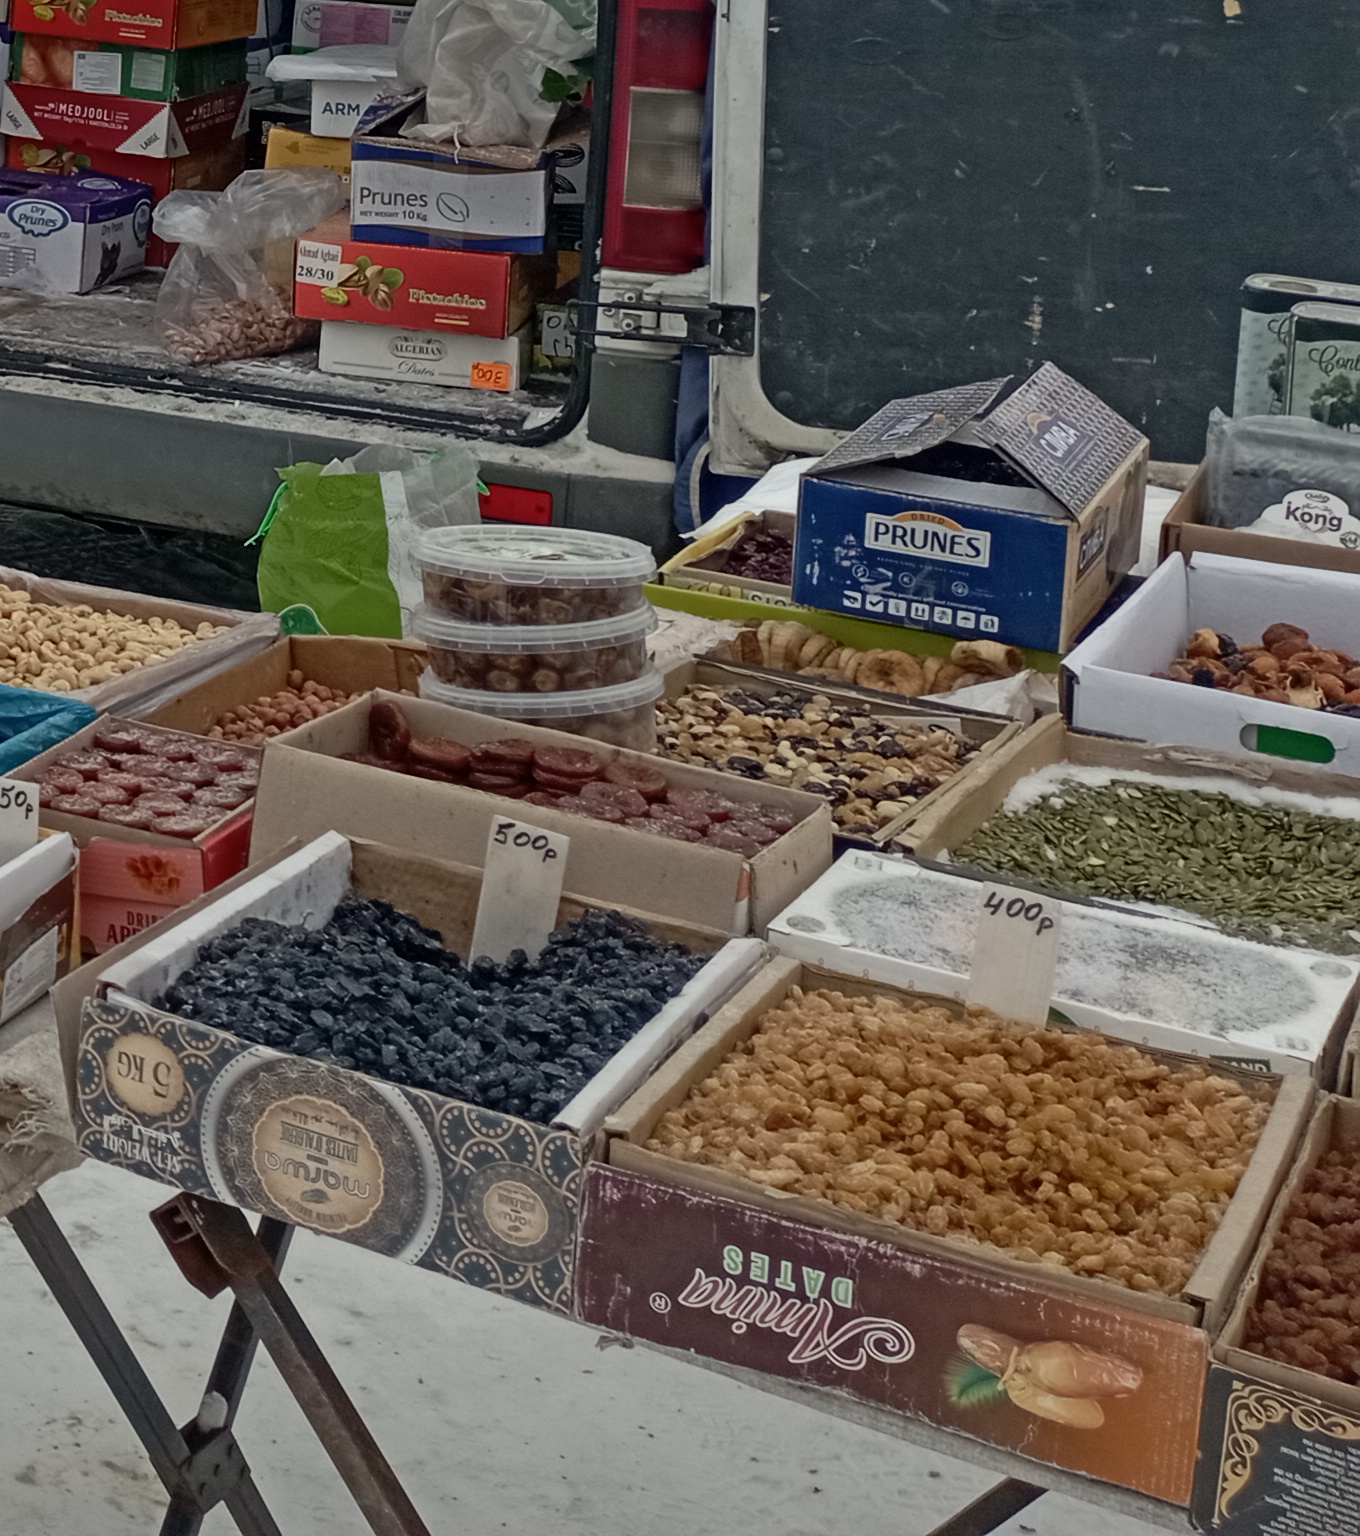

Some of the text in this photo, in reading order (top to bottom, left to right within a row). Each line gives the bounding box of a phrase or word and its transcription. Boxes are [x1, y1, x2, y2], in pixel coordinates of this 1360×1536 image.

[104, 9, 163, 27] Pistachios
[5, 110, 22, 130] LARGE
[58, 103, 110, 121] MEDJOOL
[139, 132, 161, 151] LARGE
[360, 186, 428, 208] Prunes
[18, 213, 58, 228] Prunes
[30, 204, 47, 216] Dry
[402, 210, 415, 220] 10
[297, 264, 334, 282] 28/30
[408, 288, 487, 309] Pistachios
[393, 343, 443, 356] ALGERIAN
[397, 361, 436, 377] Dates
[1039, 420, 1081, 458] CIMBA
[910, 513, 945, 525] DRIED
[873, 521, 982, 559] PRUNES
[493, 822, 558, 863] 500р
[983, 891, 1054, 936] 400р
[116, 1051, 173, 1098] 5 KG
[278, 1123, 358, 1163] DATTES D'ALGERIE
[100, 1136, 181, 1172] NET WEIGHT
[263, 1150, 371, 1200] marwa
[722, 1244, 854, 1309] DATES
[677, 1267, 916, 1371] Amina
